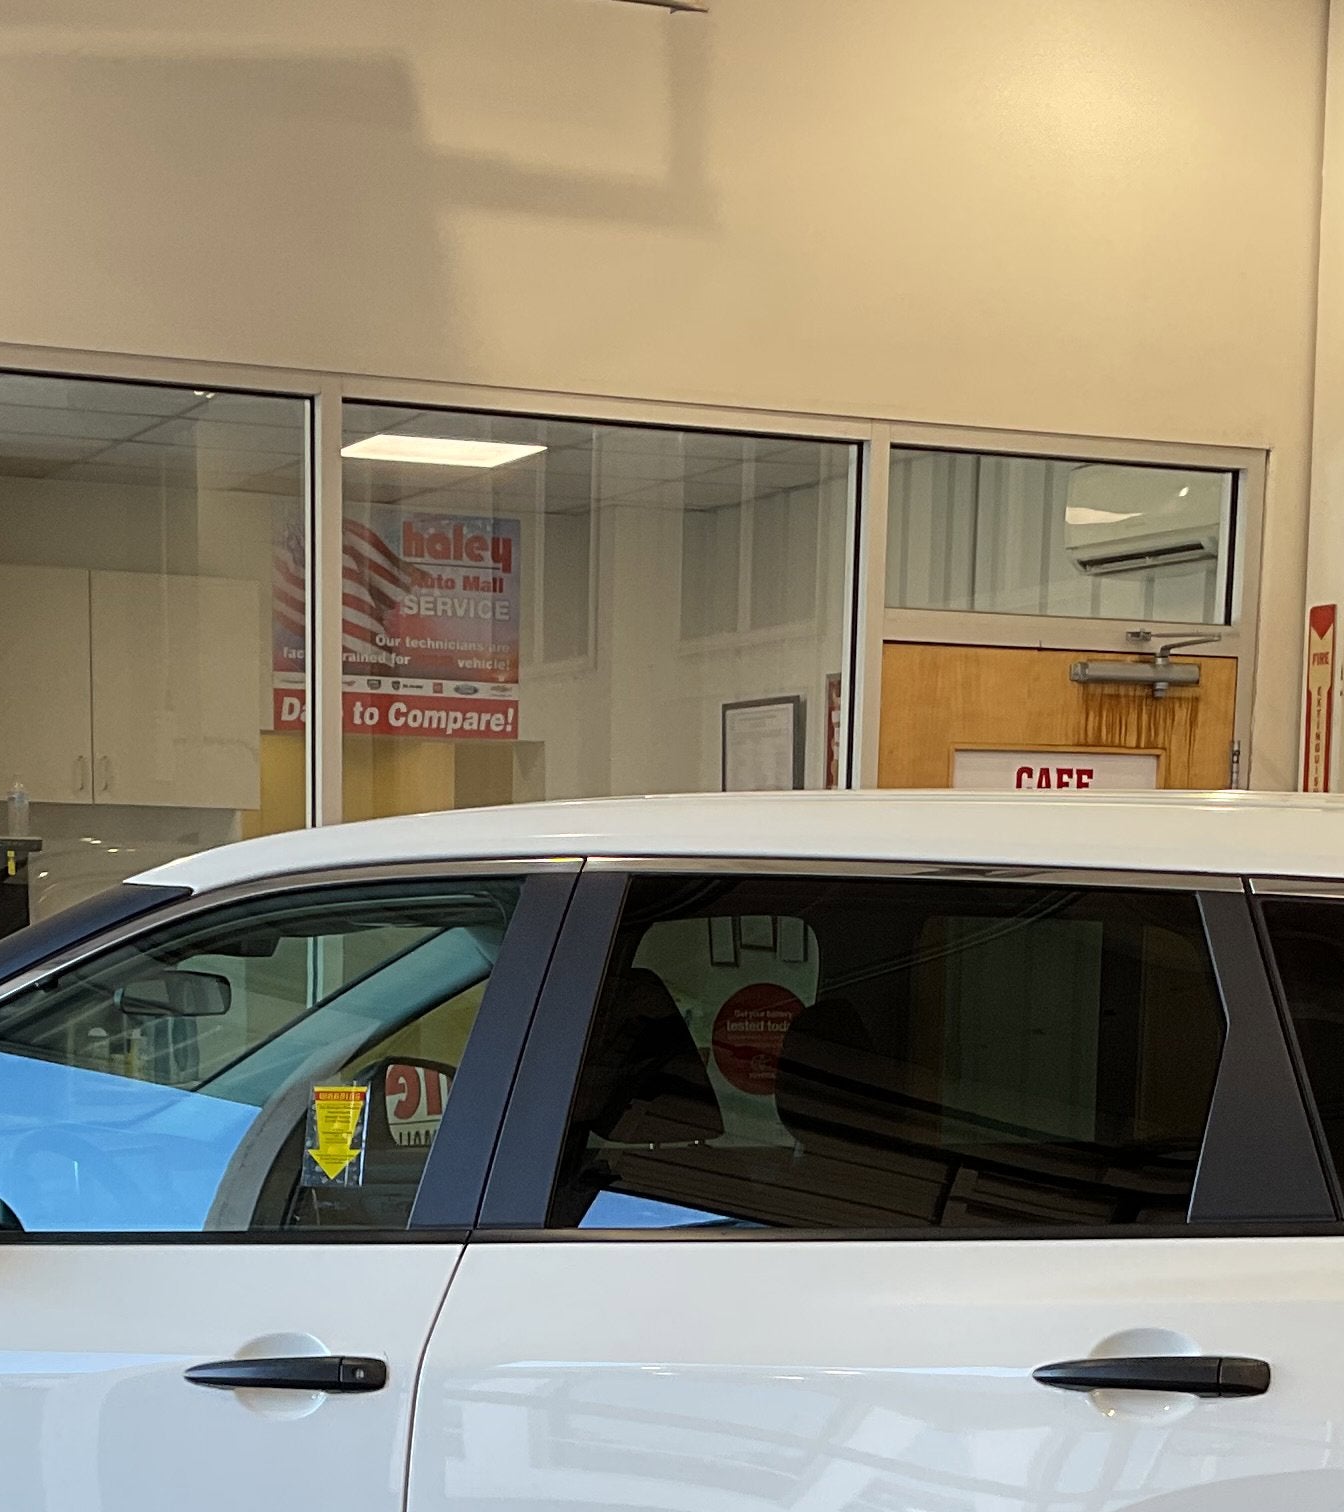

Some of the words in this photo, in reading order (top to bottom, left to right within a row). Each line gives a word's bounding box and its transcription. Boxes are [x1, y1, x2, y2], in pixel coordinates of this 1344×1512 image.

[402, 521, 512, 573] haley
[412, 574, 453, 591] Auto
[462, 575, 504, 593] Mall
[400, 597, 510, 622] SERVICE
[375, 634, 401, 649] Our
[405, 635, 485, 652] technicians
[342, 649, 387, 664] rained
[390, 653, 411, 666] for
[457, 657, 511, 671] vehicle!
[1312, 651, 1331, 666] FIRE
[353, 701, 379, 726] to
[388, 701, 514, 734] Compare!
[1313, 685, 1322, 793] EXTINGUIS
[726, 1019, 765, 1032] tested
[767, 1019, 791, 1032] tod
